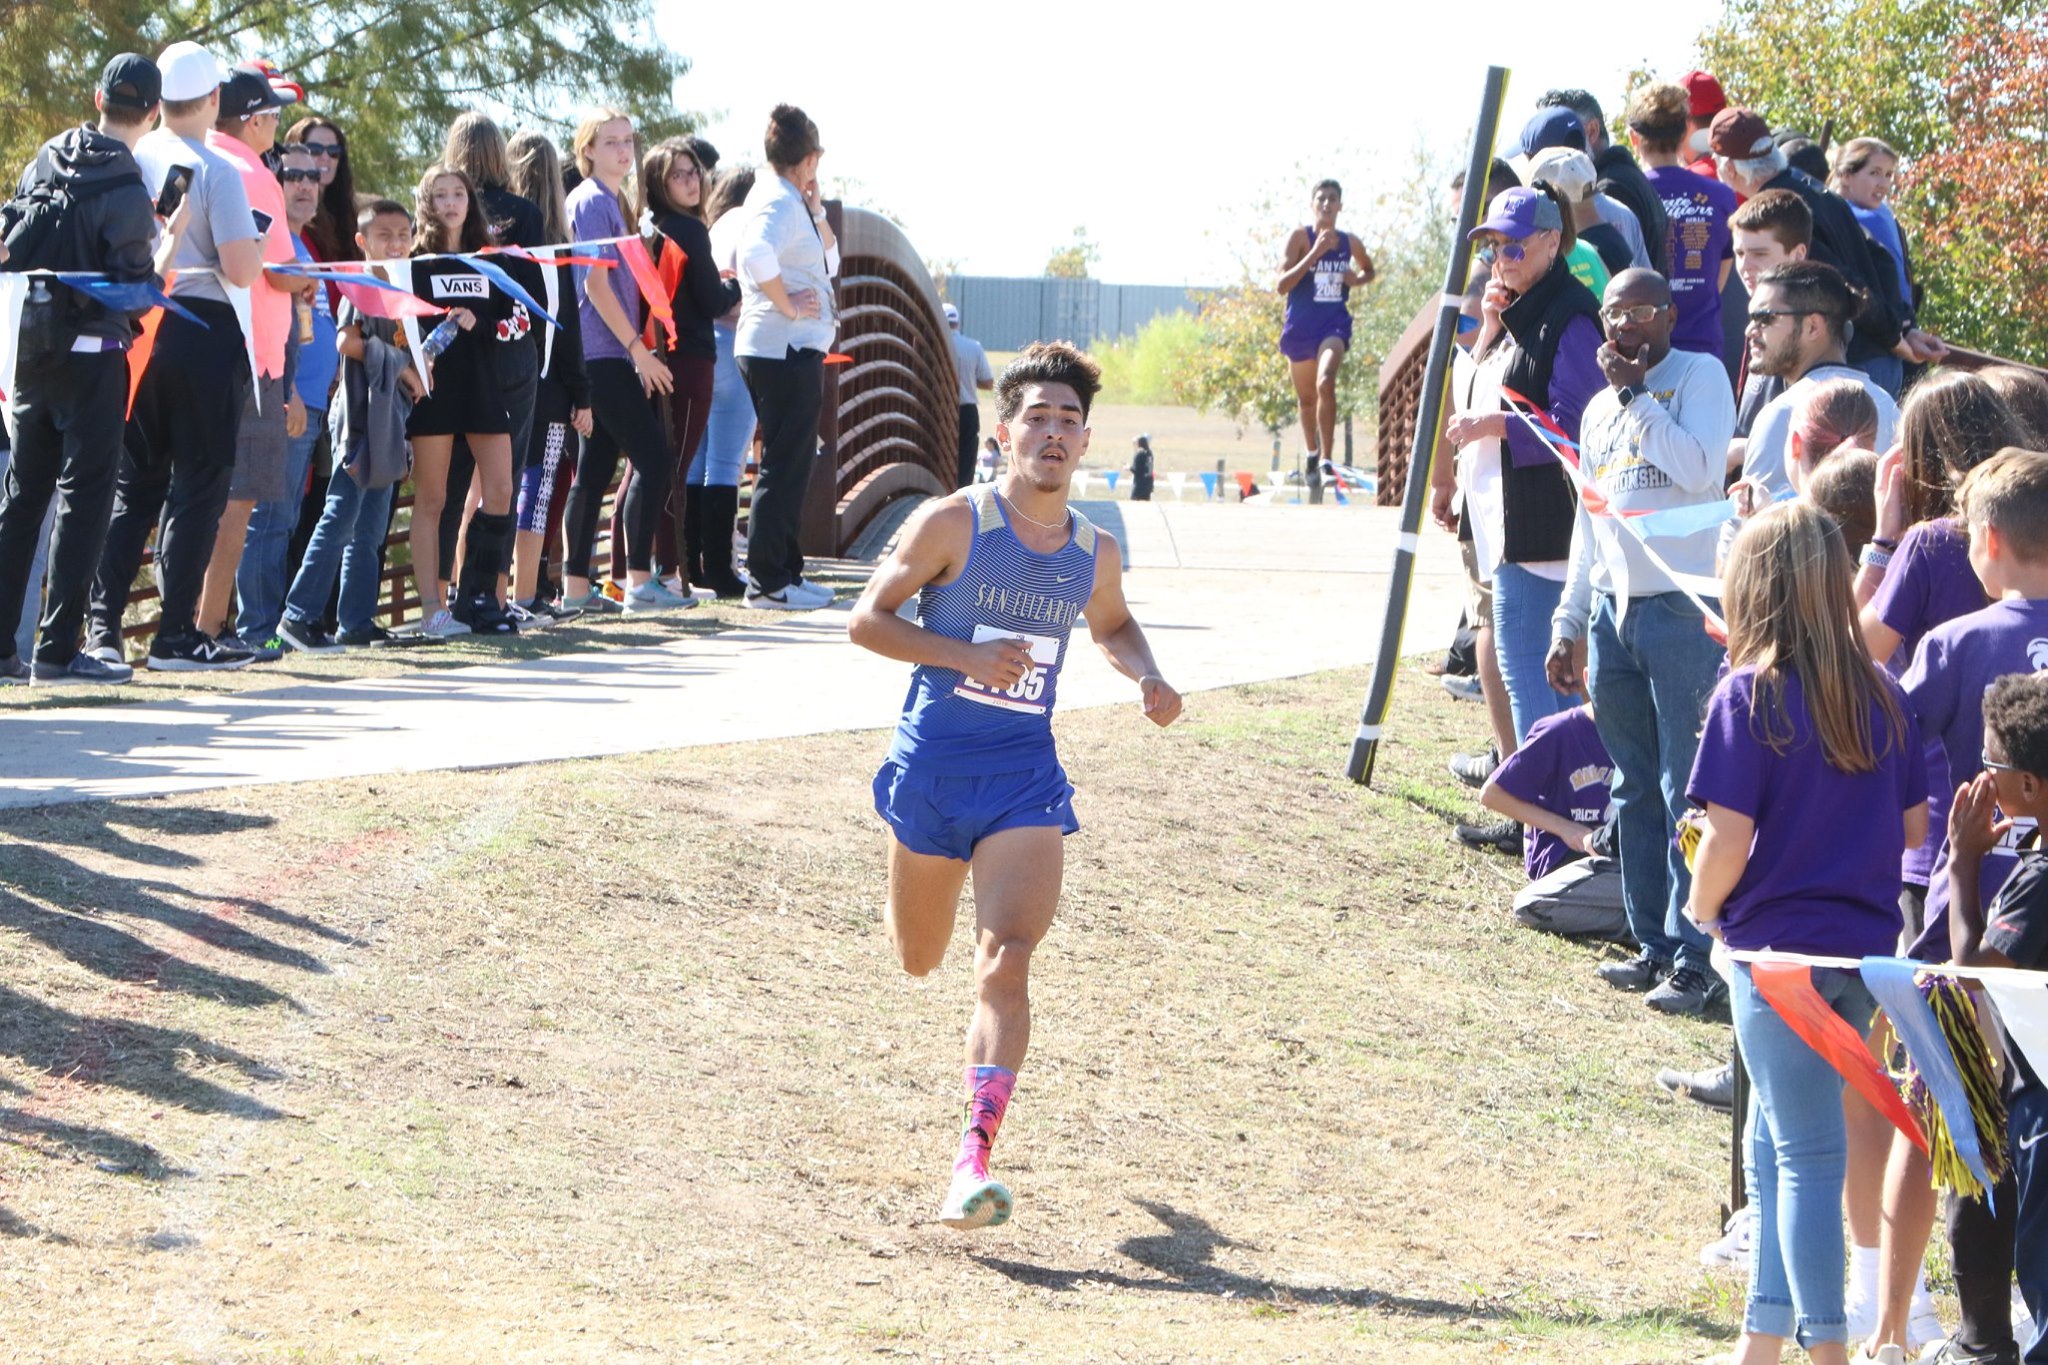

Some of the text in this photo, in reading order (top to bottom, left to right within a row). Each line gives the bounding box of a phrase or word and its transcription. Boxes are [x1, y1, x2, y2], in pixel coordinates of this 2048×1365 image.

[440, 278, 482, 293] VANS
[975, 583, 1077, 626] SAN ELIZARIO
[964, 663, 1047, 701] 35
